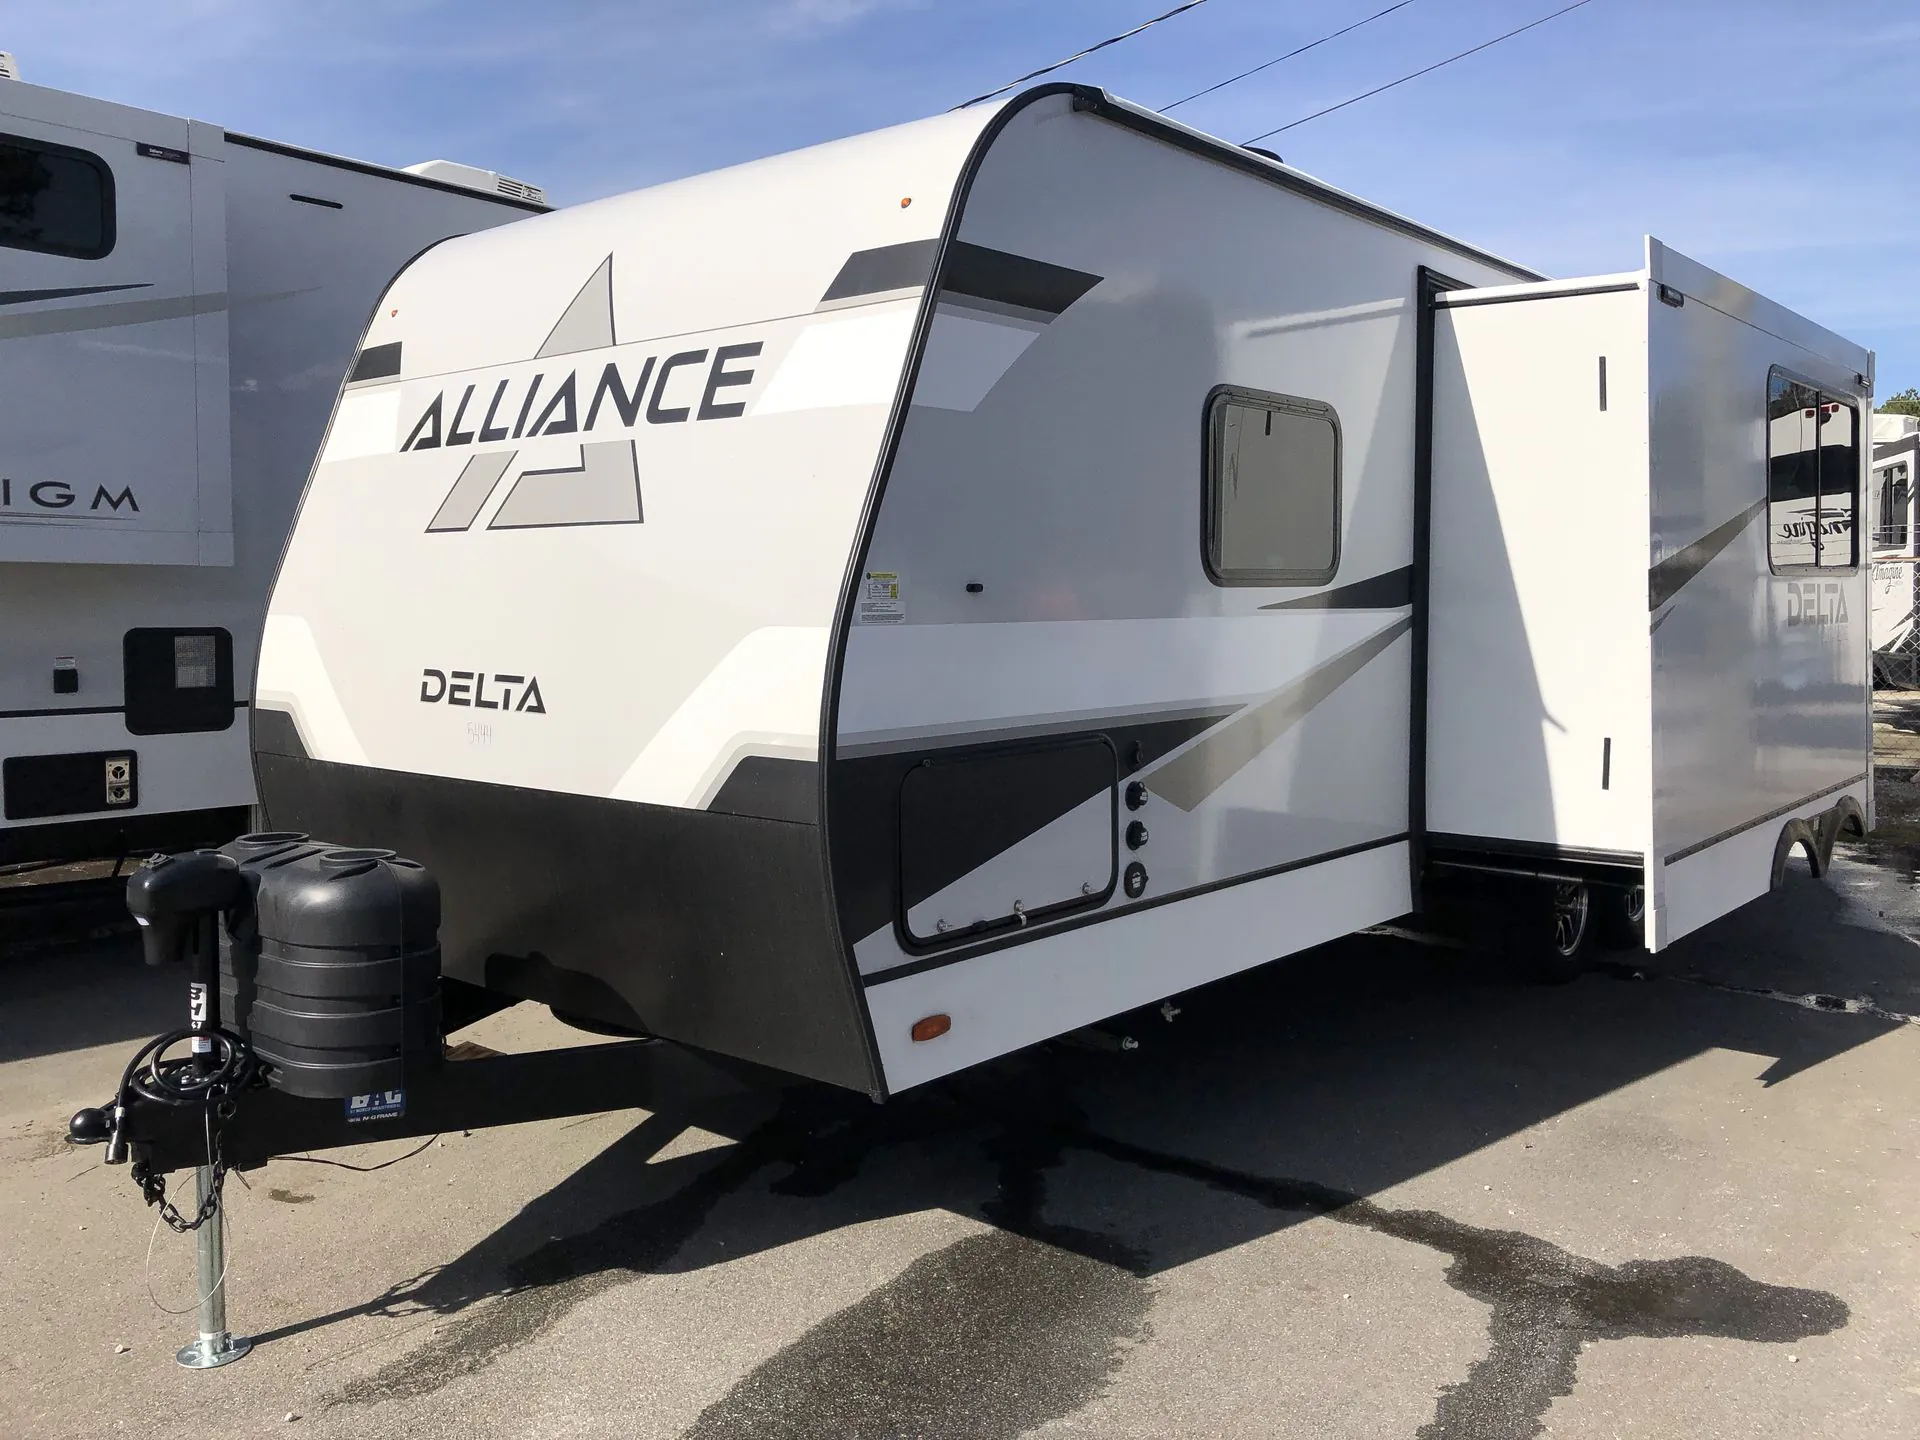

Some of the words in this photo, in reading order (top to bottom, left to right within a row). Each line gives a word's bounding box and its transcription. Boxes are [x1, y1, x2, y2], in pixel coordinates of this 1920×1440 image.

[399, 341, 764, 453] ALLIANCE
[2, 478, 140, 512] IGM
[1787, 582, 1849, 627] DELTA
[420, 668, 547, 714] DELTA
